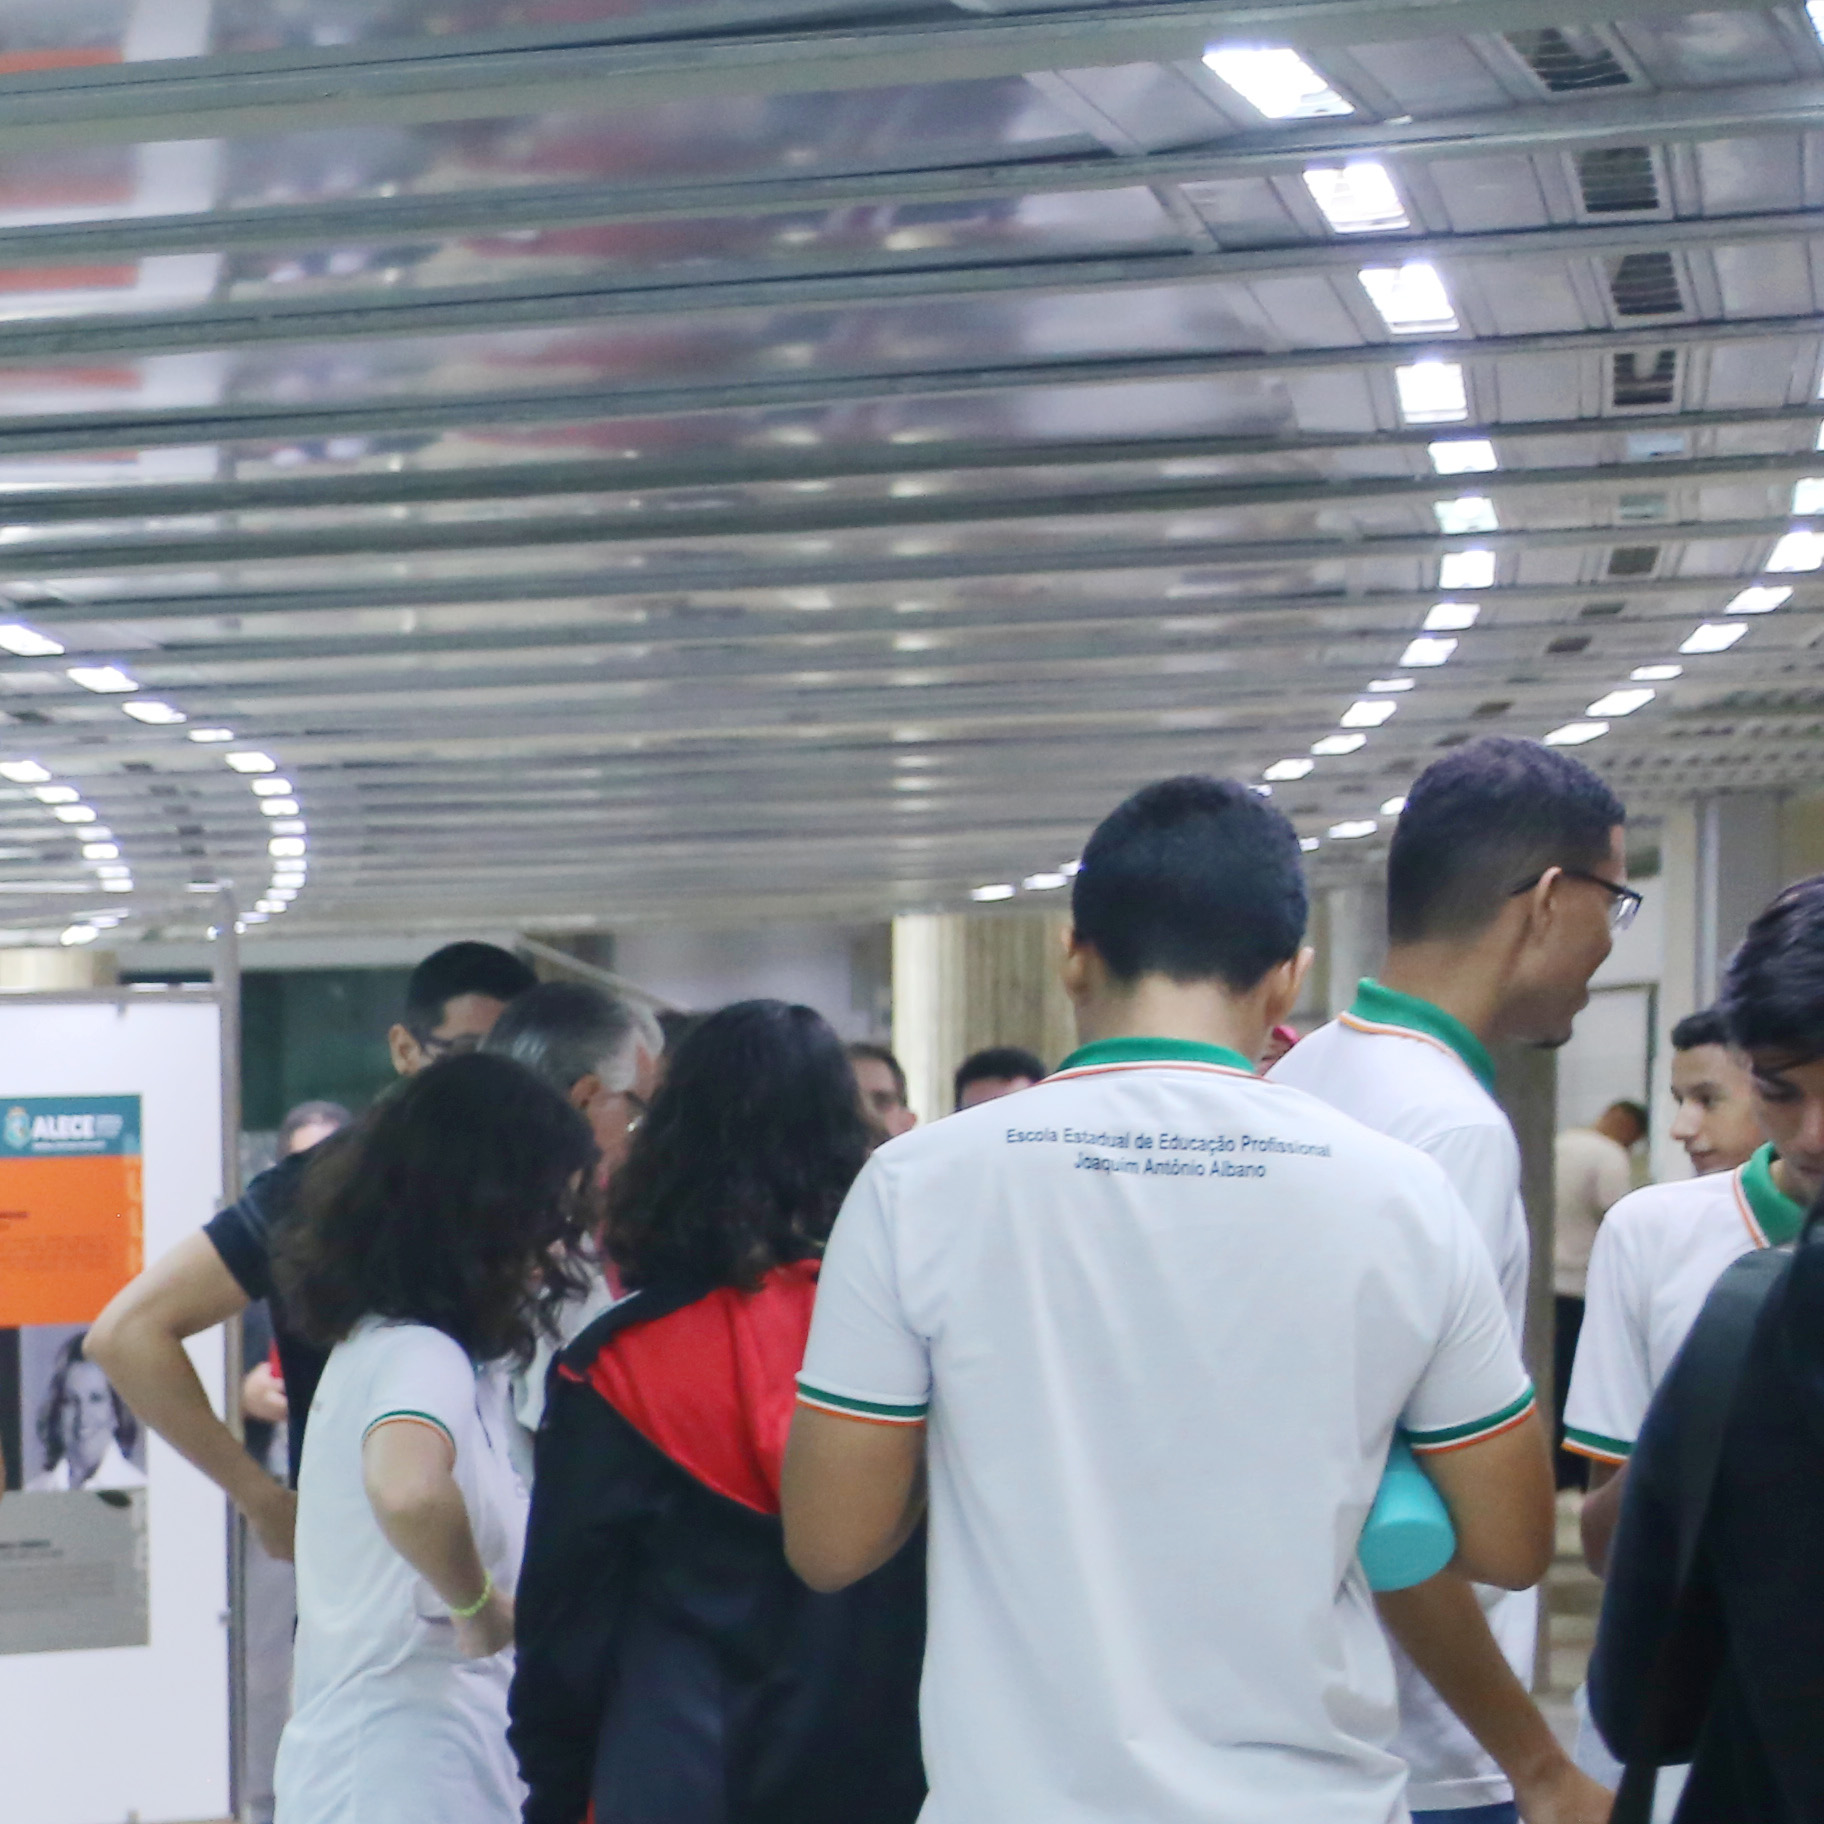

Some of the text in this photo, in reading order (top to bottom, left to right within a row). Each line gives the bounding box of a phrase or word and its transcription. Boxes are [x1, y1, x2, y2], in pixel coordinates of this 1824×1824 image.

[1006, 1127, 1333, 1157] Escola Estadual de Educação Profissional
[1074, 1151, 1139, 1175] Joaquim
[1210, 1159, 1266, 1178] Albano
